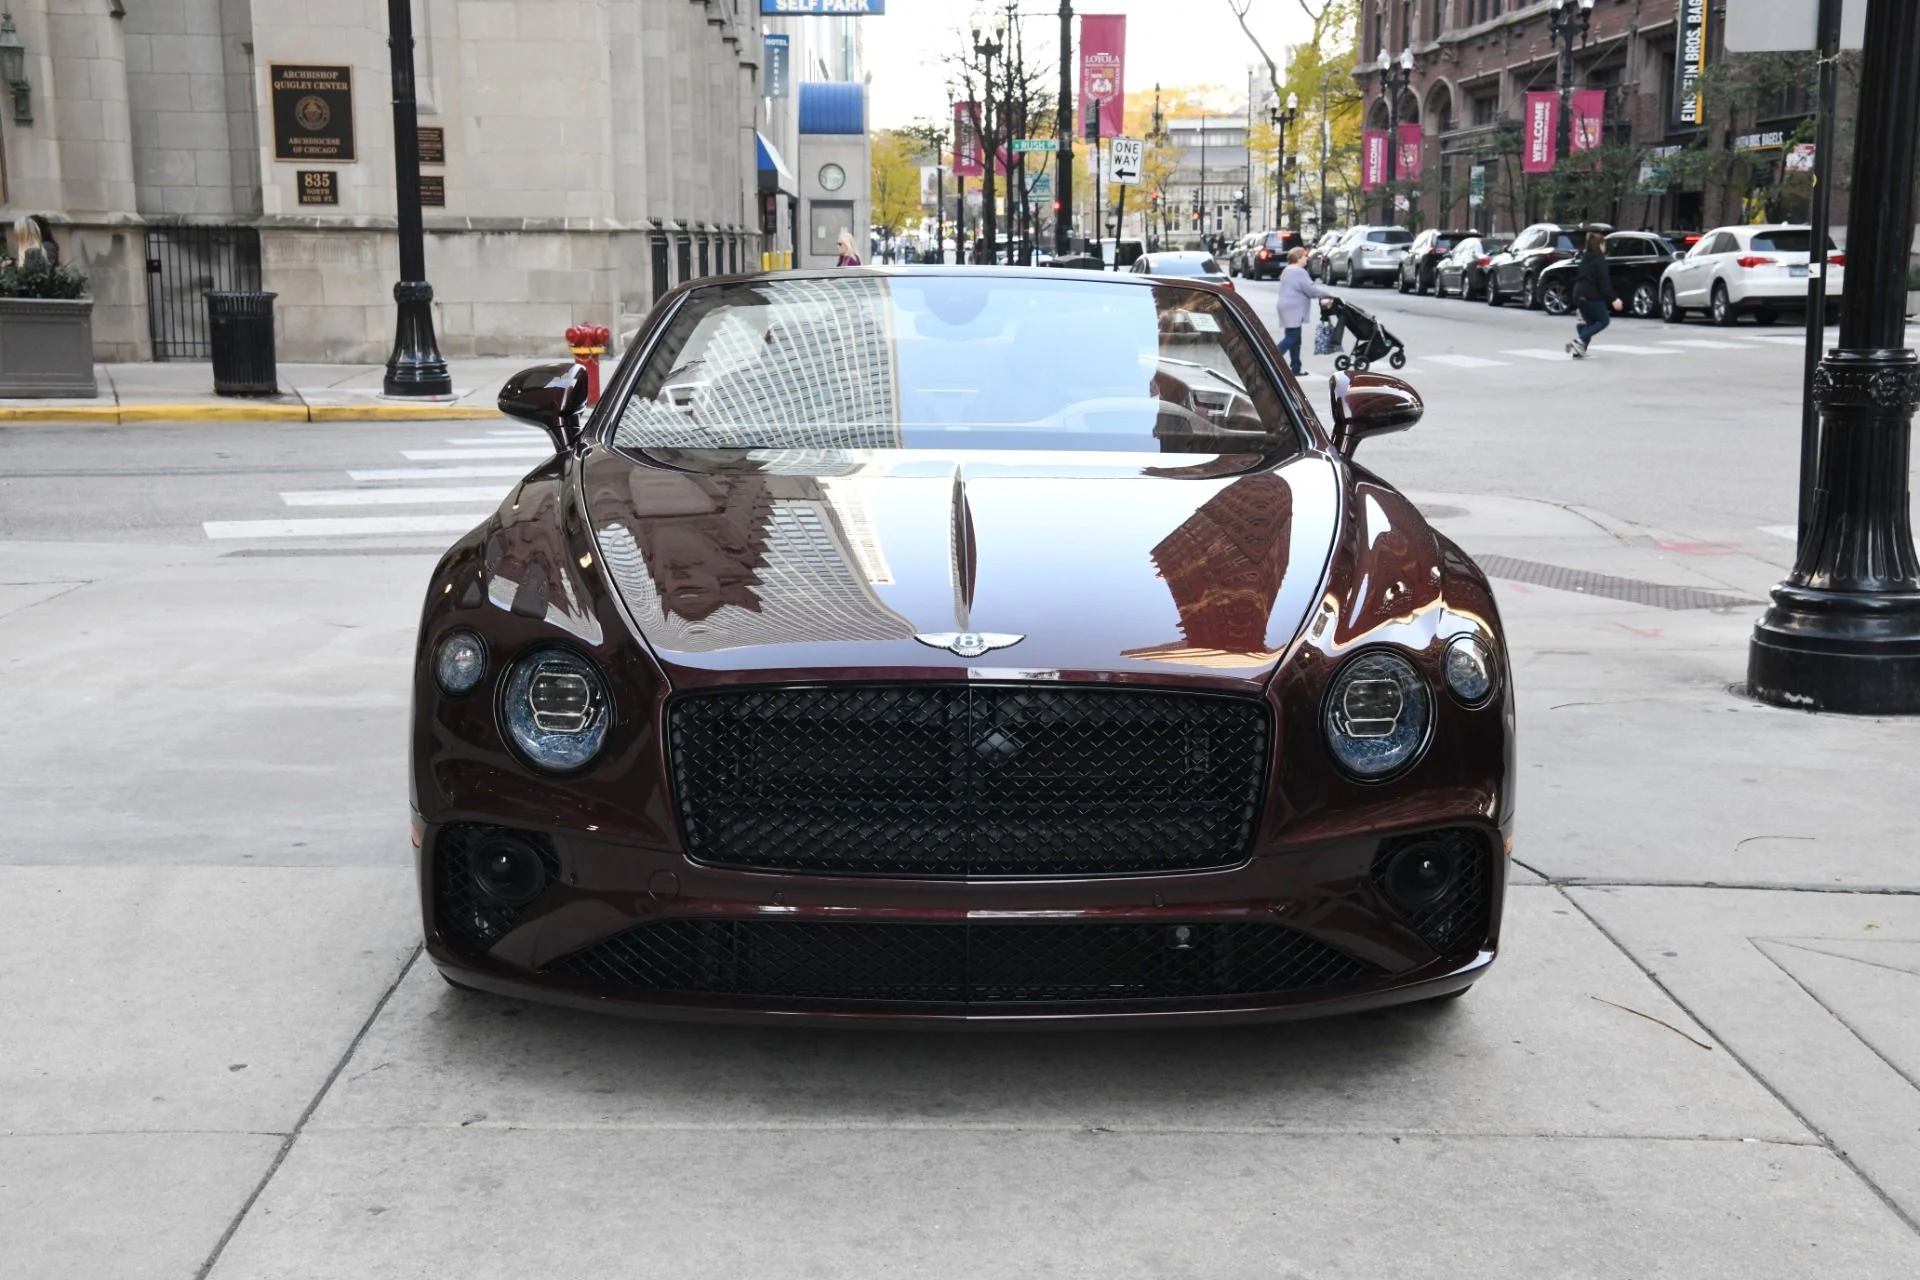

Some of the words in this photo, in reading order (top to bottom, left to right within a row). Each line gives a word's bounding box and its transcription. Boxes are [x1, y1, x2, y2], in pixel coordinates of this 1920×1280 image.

[776, 0, 817, 11] SELF
[823, 0, 869, 11] PARK
[765, 38, 788, 46] HOTEL
[1085, 55, 1120, 63] LOYOLA
[282, 70, 339, 79] ARCHBISHOP
[274, 81, 312, 90] QUIGLEY
[313, 82, 348, 90] CENTER
[1532, 102, 1545, 162] WELCOME
[288, 137, 341, 145] ARCHDIOCESE
[1021, 140, 1046, 151] RUSH
[304, 146, 337, 154] CHICAGO
[1116, 142, 1139, 154] ONE
[1114, 154, 1139, 166] WAY
[1369, 138, 1378, 183] WELCOME
[305, 173, 330, 187] 835
